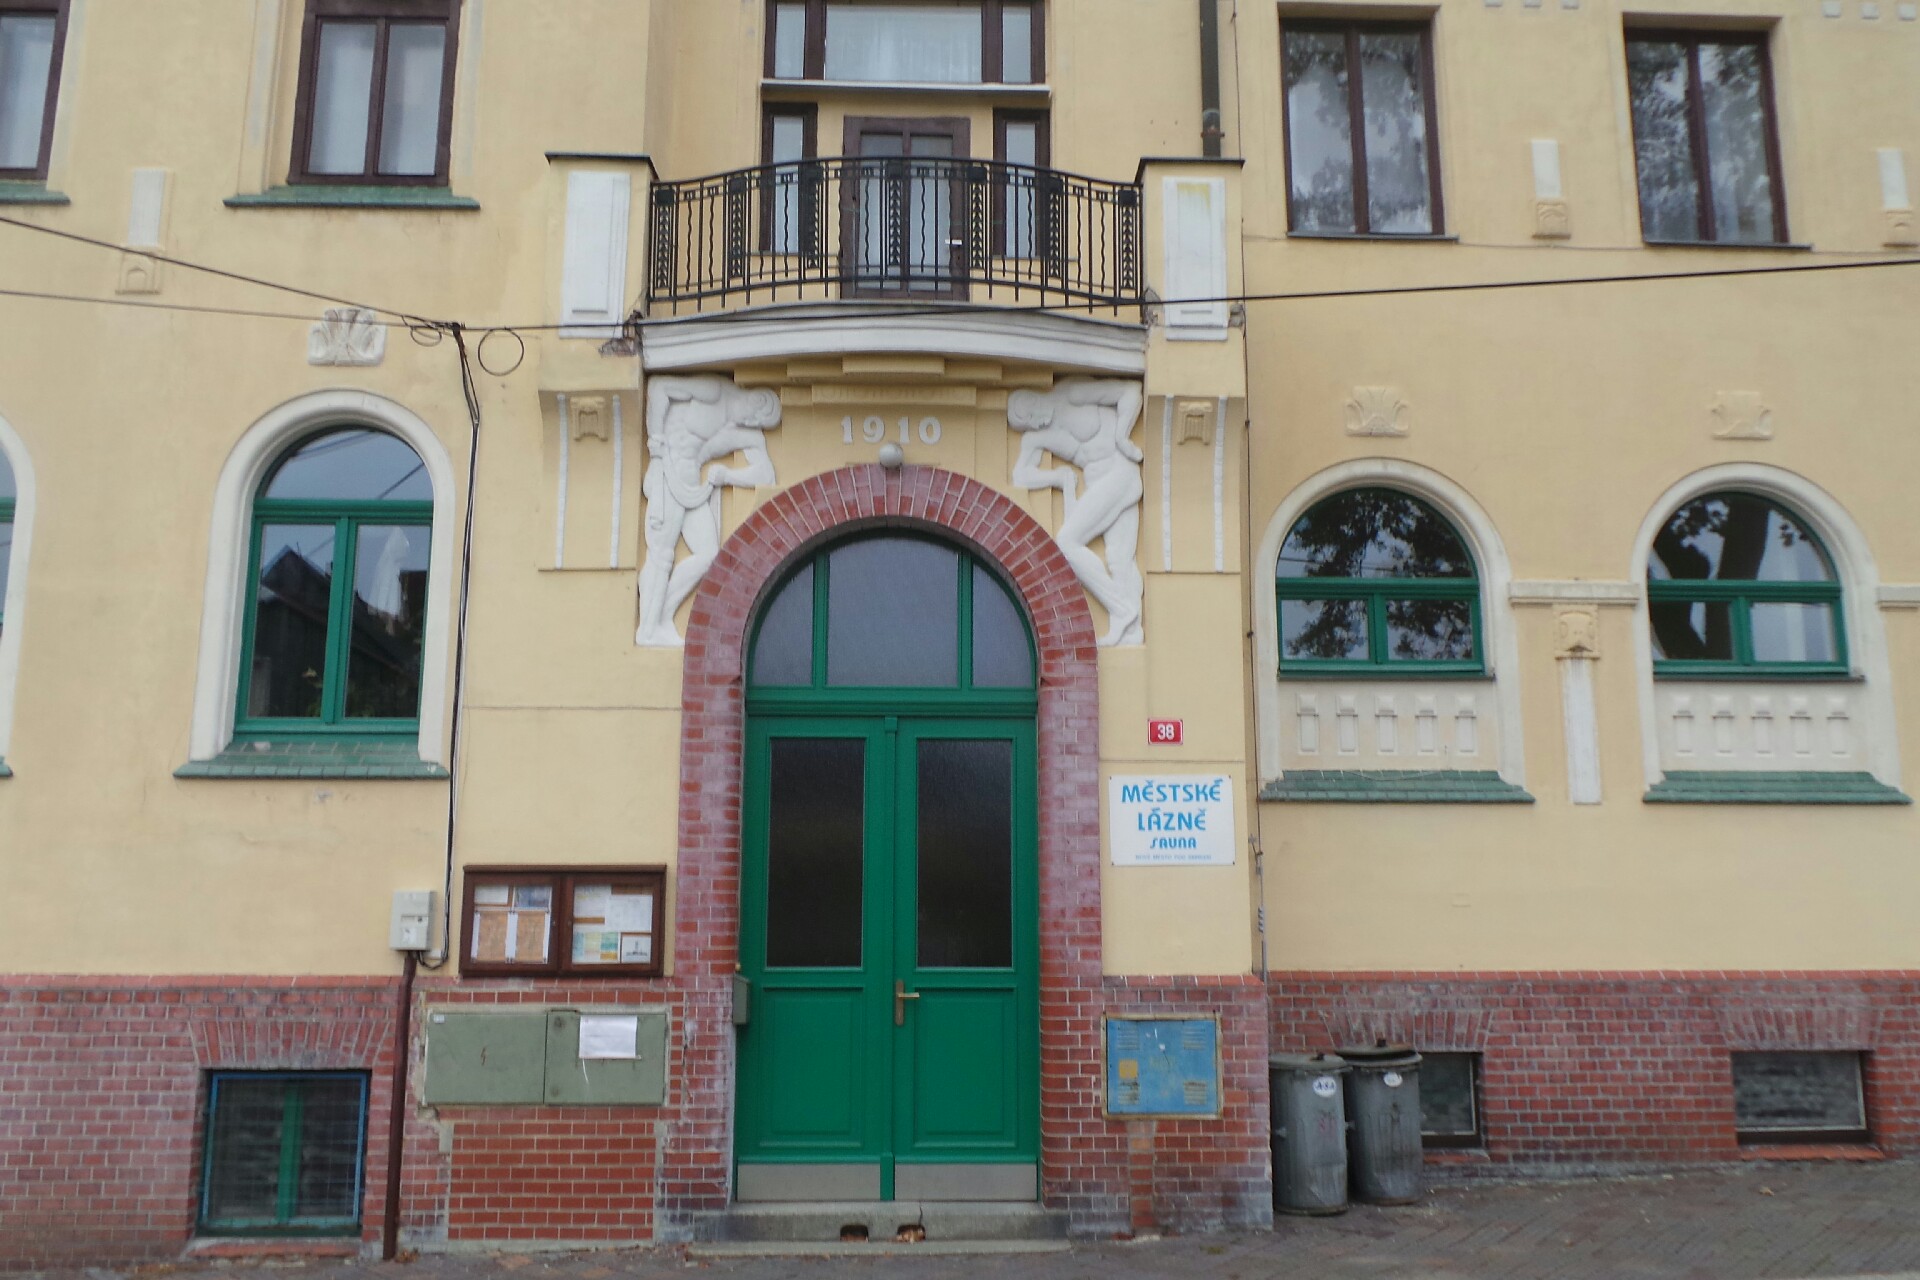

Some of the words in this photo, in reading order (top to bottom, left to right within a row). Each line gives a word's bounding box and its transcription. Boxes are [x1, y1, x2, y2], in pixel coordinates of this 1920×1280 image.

[841, 416, 942, 445] 1910
[1157, 723, 1175, 741] 38
[1121, 778, 1223, 803] MĚSTSKÉ
[1138, 807, 1207, 832] LÁZNĚ
[1149, 836, 1198, 850] SAUNA
